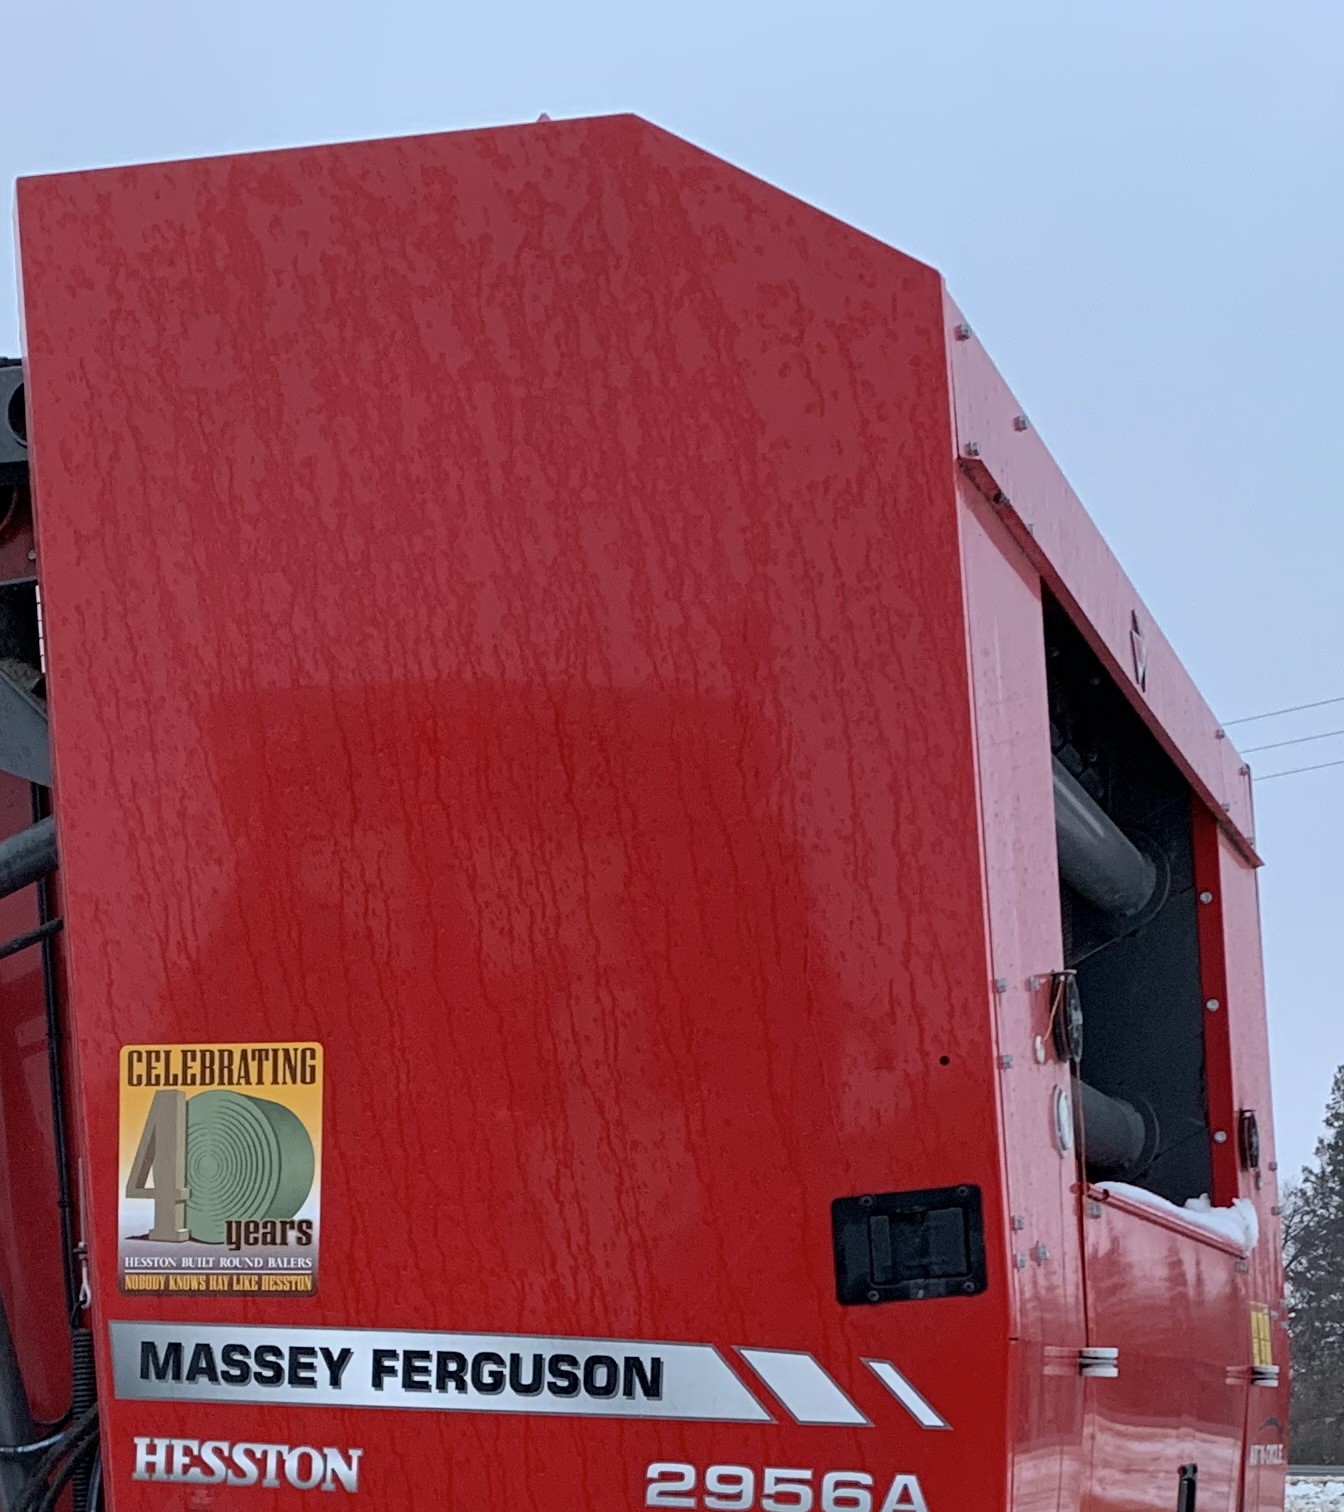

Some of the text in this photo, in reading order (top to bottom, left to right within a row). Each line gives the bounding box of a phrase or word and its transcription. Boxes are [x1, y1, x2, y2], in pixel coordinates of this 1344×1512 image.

[127, 1047, 316, 1087] CELEBRATING
[225, 1219, 313, 1251] years
[124, 1257, 312, 1268] HESSTON BUILT ROUND BALERS
[124, 1275, 312, 1292] NOBODY KNOWS HAY LIKE HESSTON
[139, 1340, 664, 1401] MASSEY FERGUSON
[131, 1436, 363, 1493] HESSTON
